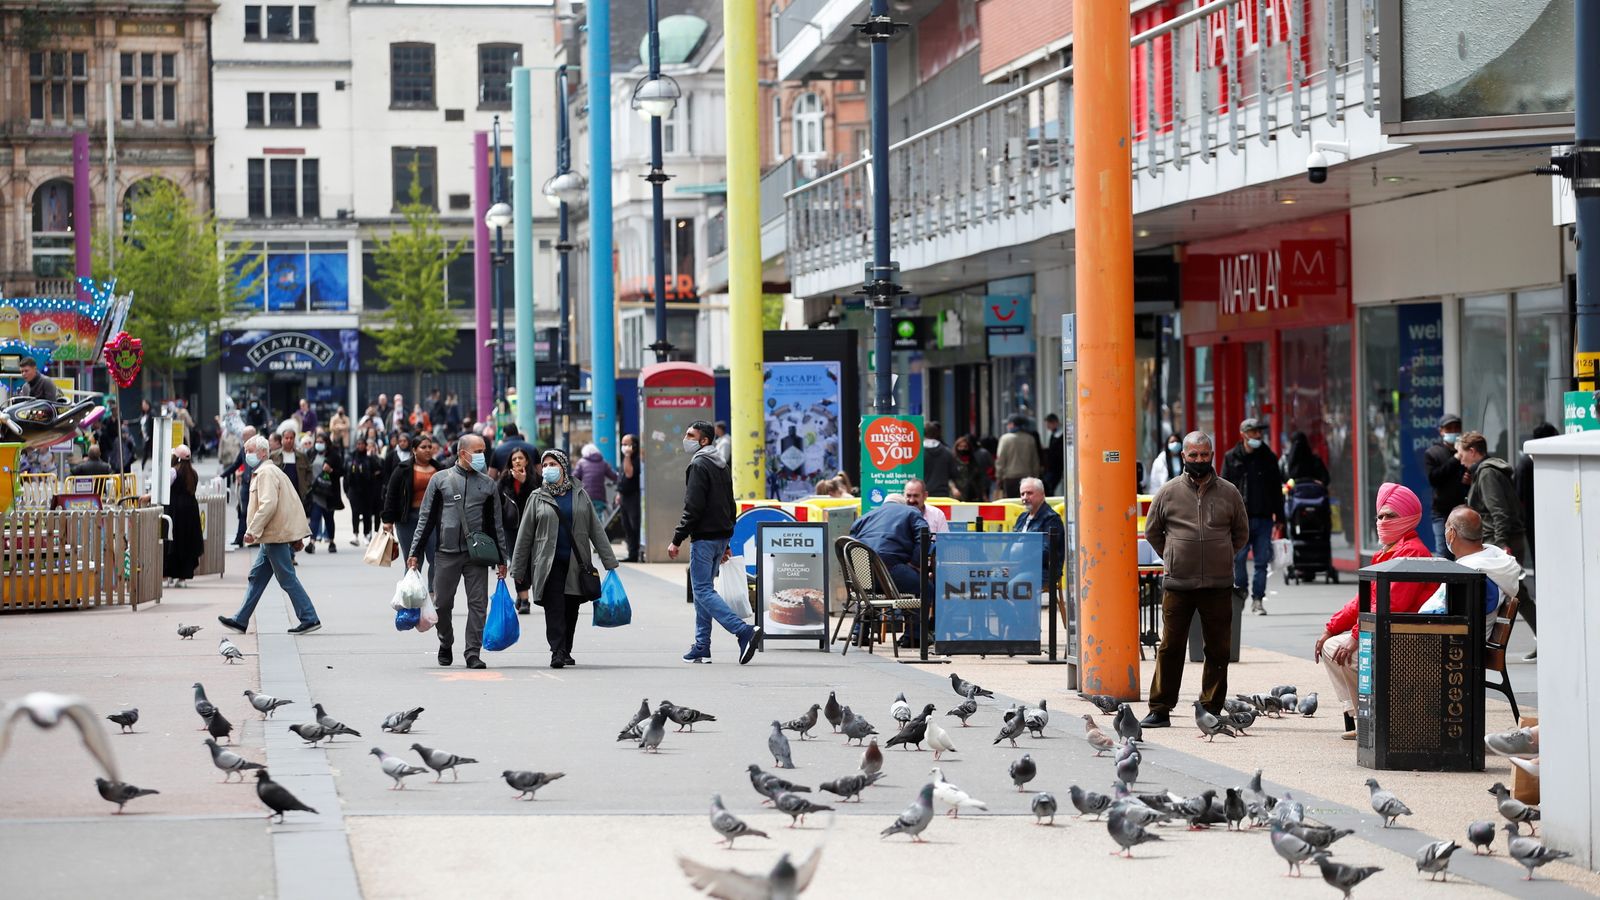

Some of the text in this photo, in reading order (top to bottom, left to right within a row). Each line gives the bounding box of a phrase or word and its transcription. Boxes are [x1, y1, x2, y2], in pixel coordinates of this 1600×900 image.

[252, 337, 330, 361] FLAWLESS
[294, 361, 312, 370] VAPE
[779, 374, 817, 383] ESCAPE
[1410, 394, 1442, 409] food
[1413, 413, 1440, 428] bab
[881, 424, 907, 433] We've
[871, 431, 914, 445] missed
[877, 442, 913, 465] you
[771, 538, 814, 547] NERO
[944, 581, 1033, 600] NERO
